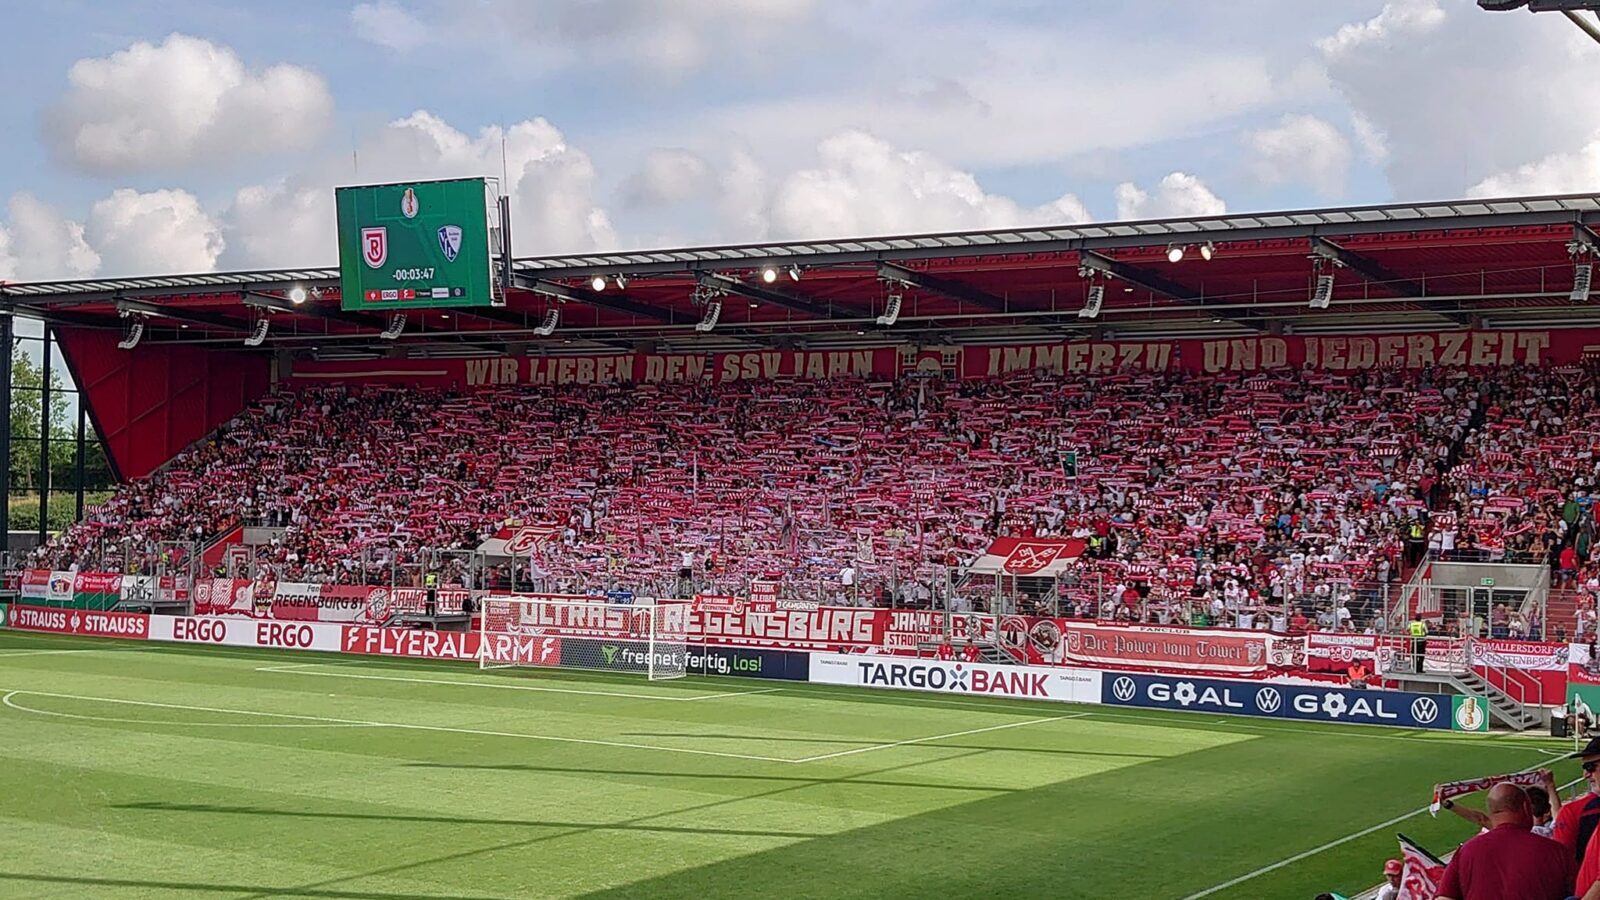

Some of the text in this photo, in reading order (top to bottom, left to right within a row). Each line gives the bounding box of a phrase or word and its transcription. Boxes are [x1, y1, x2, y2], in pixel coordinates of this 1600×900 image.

[393, 268, 434, 281] -00:03:47
[465, 332, 1550, 385] WIR LIEBEN DEN SSV JAHN IMMERZU UND JEDERZEIT
[275, 594, 349, 611] REGENSBURG
[350, 597, 366, 610] 81
[20, 610, 144, 634] STRAUSS STRAUSS
[173, 618, 313, 647] ERGO ERGO
[520, 600, 626, 629] ULTRAS
[664, 603, 874, 642] REGENSBURG
[889, 612, 930, 633] JAHN
[1139, 626, 1190, 634] FANCLUB
[365, 628, 534, 662] FLYERALARM
[1083, 634, 1243, 660] Die Power vom Tower
[685, 652, 731, 674] fertig,
[733, 654, 762, 671] los!
